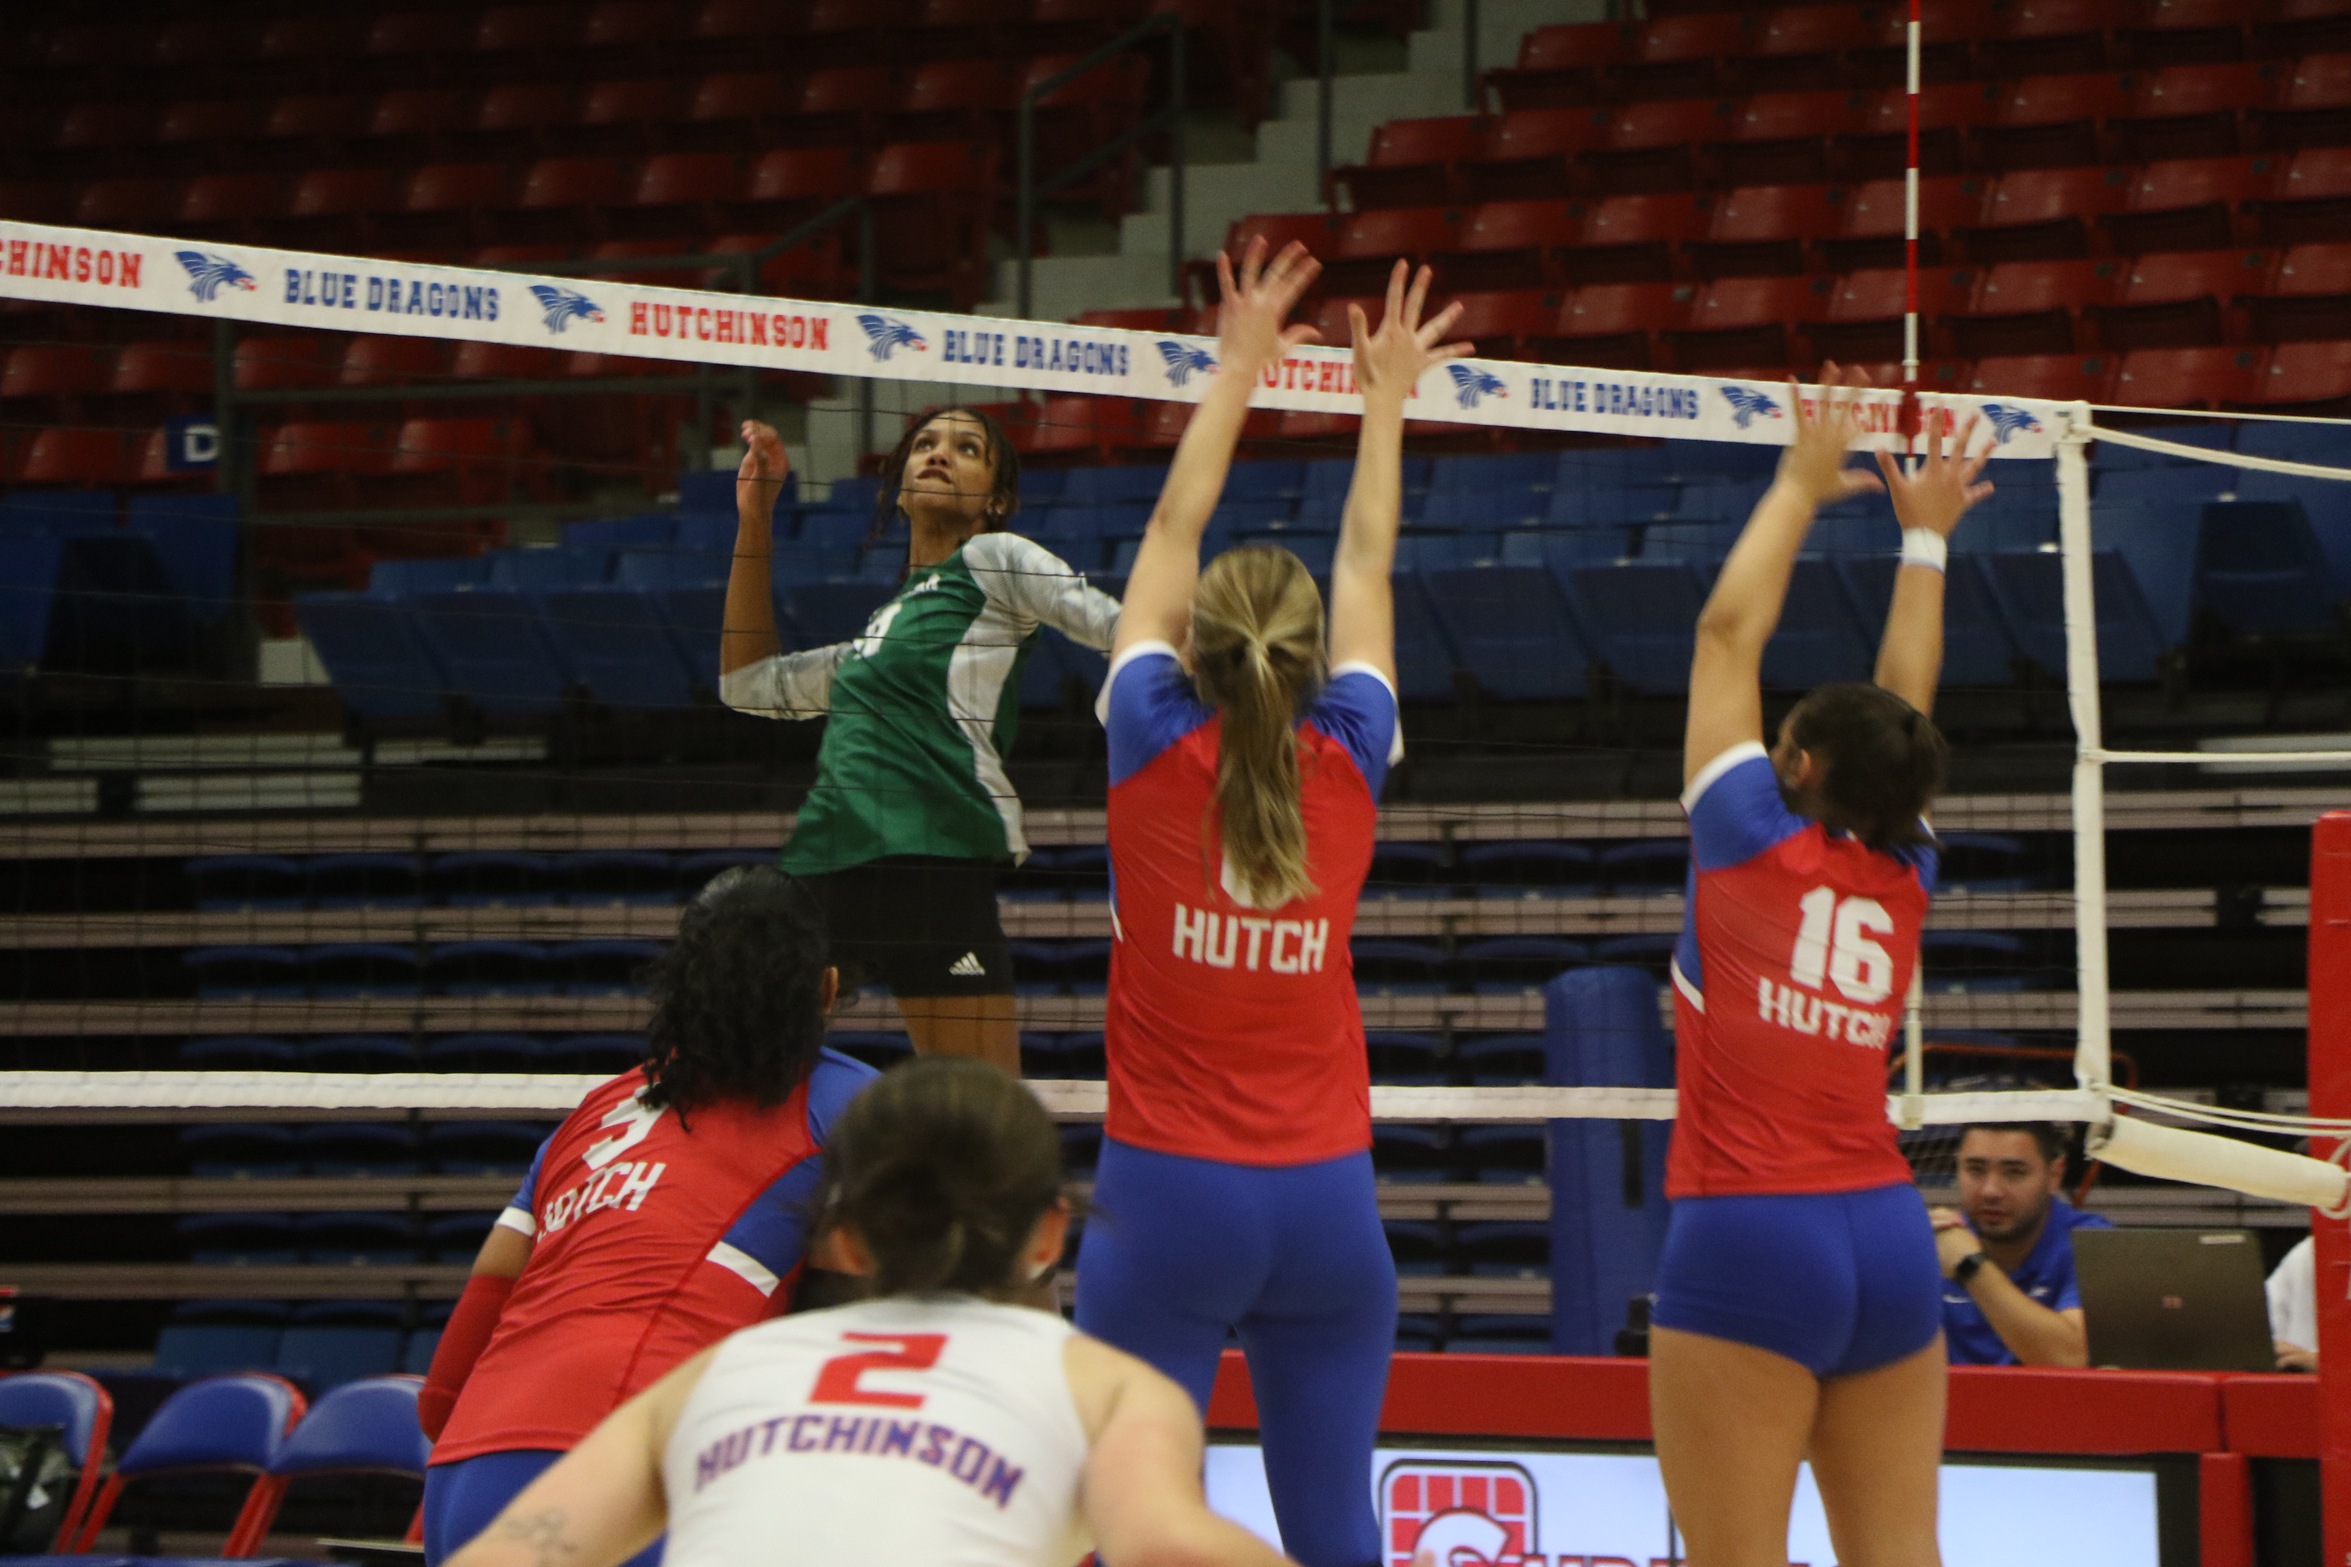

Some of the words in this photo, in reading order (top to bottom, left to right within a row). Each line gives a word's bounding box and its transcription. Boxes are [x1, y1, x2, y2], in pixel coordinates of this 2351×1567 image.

[0, 238, 143, 288] HINSON
[285, 268, 357, 309] BLUE
[366, 276, 499, 322] DRAGONS
[630, 301, 829, 351] HUTCHINSON
[944, 329, 1004, 367] BLUE
[1015, 335, 1129, 377] DRAGONS
[1531, 378, 1587, 412] BLUE
[1595, 383, 1698, 420] DRAGONS
[185, 425, 220, 462] D
[1173, 901, 1329, 975] HUTCH
[1790, 884, 1895, 1006] 16
[806, 1331, 950, 1411] 2
[693, 1413, 1025, 1513] HUTCHINSON
